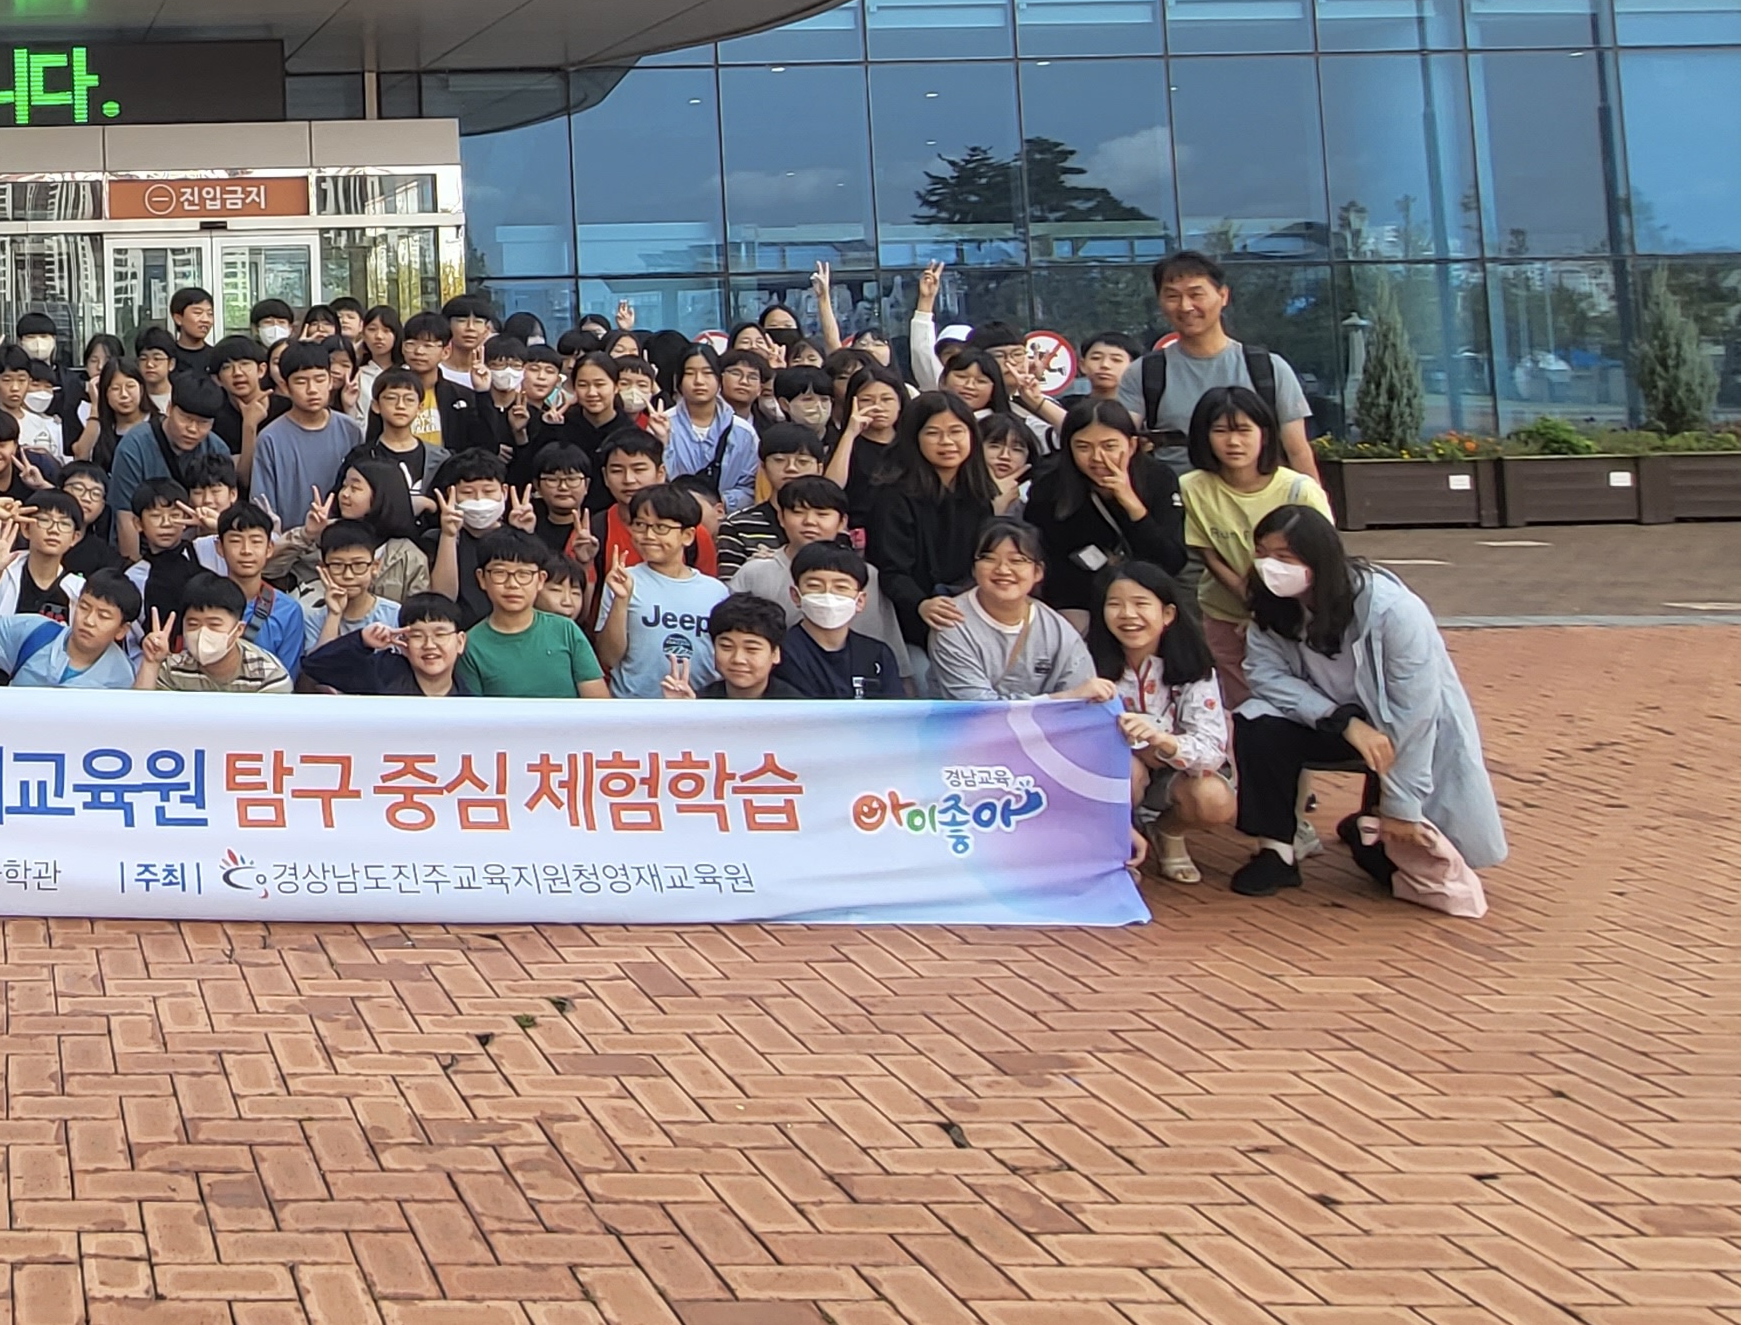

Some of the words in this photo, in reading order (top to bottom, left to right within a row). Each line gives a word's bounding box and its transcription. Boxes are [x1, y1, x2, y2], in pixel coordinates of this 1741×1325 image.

[178, 184, 268, 211] 진입금지
[641, 604, 712, 638] Jeep
[224, 748, 362, 829] 탐구
[371, 750, 511, 832] 중심
[523, 750, 804, 833] 체험학습
[944, 769, 1012, 788] 경남교육
[852, 784, 1045, 855] 아이좋아
[271, 861, 756, 895] 경상남도진주교육지원청영재교육원
